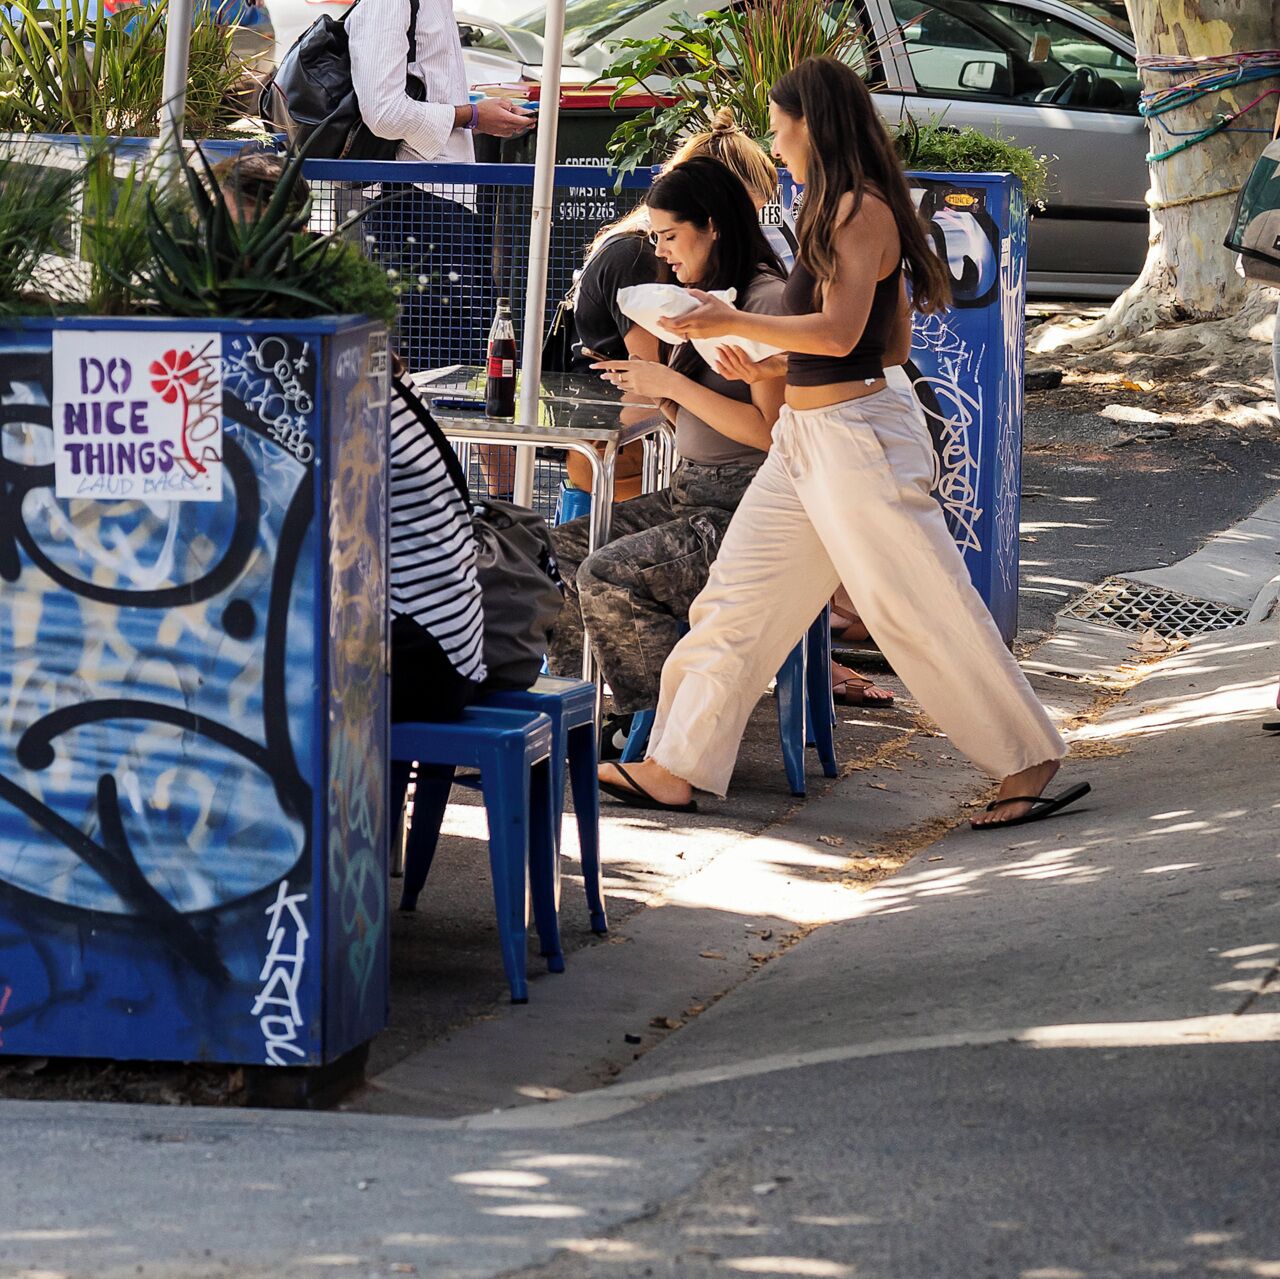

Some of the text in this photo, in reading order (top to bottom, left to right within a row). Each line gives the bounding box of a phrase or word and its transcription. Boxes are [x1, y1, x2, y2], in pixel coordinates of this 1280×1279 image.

[560, 202, 615, 220] 9305 2265
[78, 356, 133, 395] DO
[63, 400, 149, 436] NICE
[63, 439, 175, 476] THINGS
